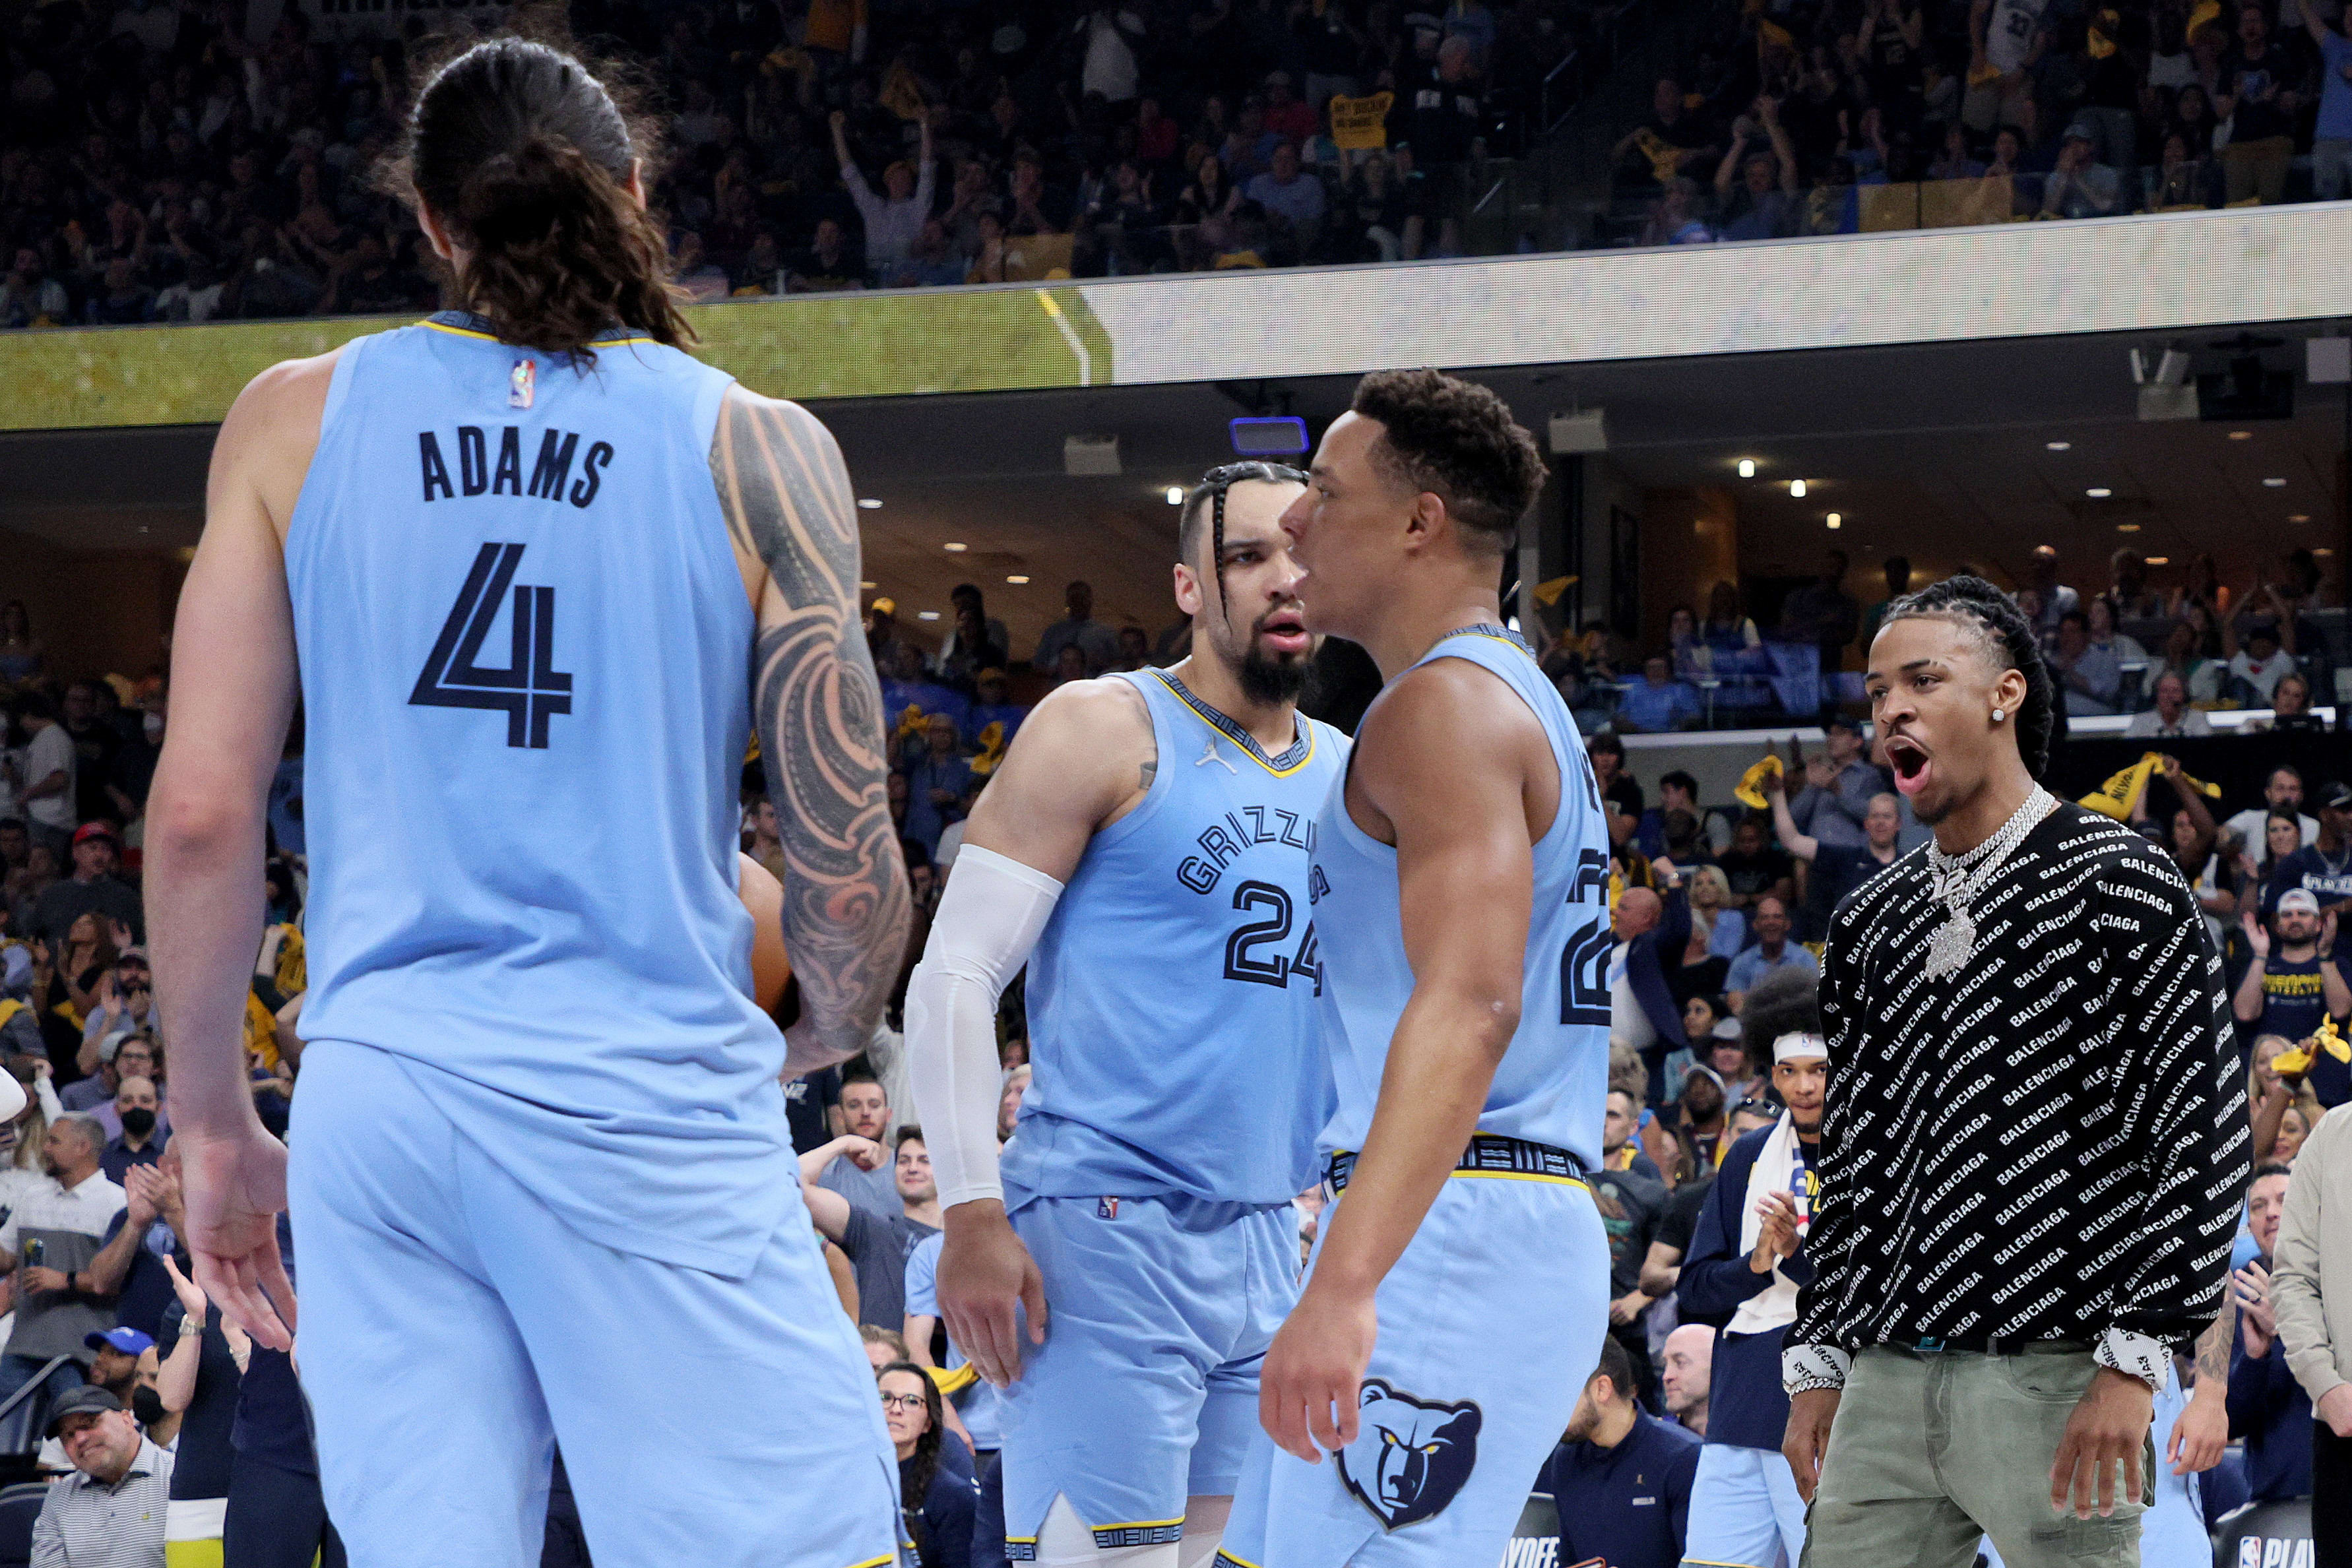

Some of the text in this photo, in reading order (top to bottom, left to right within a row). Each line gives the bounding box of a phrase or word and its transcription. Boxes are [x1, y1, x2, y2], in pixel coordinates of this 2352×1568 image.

[419, 425, 614, 509] ADAMS
[407, 542, 573, 749] 4
[2024, 863, 2102, 912] BALENCIAGA
[2039, 843, 2128, 879] BALENCIAGA
[1841, 865, 1912, 927] BALENCIAGA
[2017, 898, 2087, 950] BALENCIAGA
[1941, 956, 2006, 1022] BALENCIAGA
[2139, 953, 2200, 1032] BALENCIAGA
[1881, 994, 1938, 1061] BALENCIAGA
[1938, 995, 2003, 1060] BALENCIAGA
[1883, 1032, 1934, 1100] BALENCIAGA
[1934, 1034, 2000, 1098] BALENCIAGA
[2002, 1053, 2076, 1106] BALENCIAGA
[1885, 1071, 1931, 1139] BALENCIAGA
[1930, 1074, 1995, 1137] BALENCIAGA
[1999, 1092, 2073, 1146] BALENCIAGA
[2151, 1061, 2206, 1134] BALENCIAGA
[1884, 1110, 1928, 1178] BALENCIAGA
[1924, 1113, 1991, 1176] BALENCIAGA
[1996, 1130, 2072, 1185] BALENCIAGA
[2211, 1124, 2251, 1165] BALENCIAGA
[1882, 1148, 1923, 1217] BALENCIAGA
[1921, 1152, 1988, 1214] BALENCIAGA
[1995, 1169, 2071, 1226] BALENCIAGA
[1919, 1191, 1986, 1254] BALENCIAGA
[1993, 1207, 2070, 1265] BALENCIAGA
[1917, 1232, 1985, 1294] BALENCIAGA
[1992, 1247, 2069, 1305] BALENCIAGA
[2124, 1236, 2184, 1292] BALENCIAGA
[1915, 1272, 1983, 1333] BALENCIAGA
[1500, 1536, 1560, 1568] YOFF
